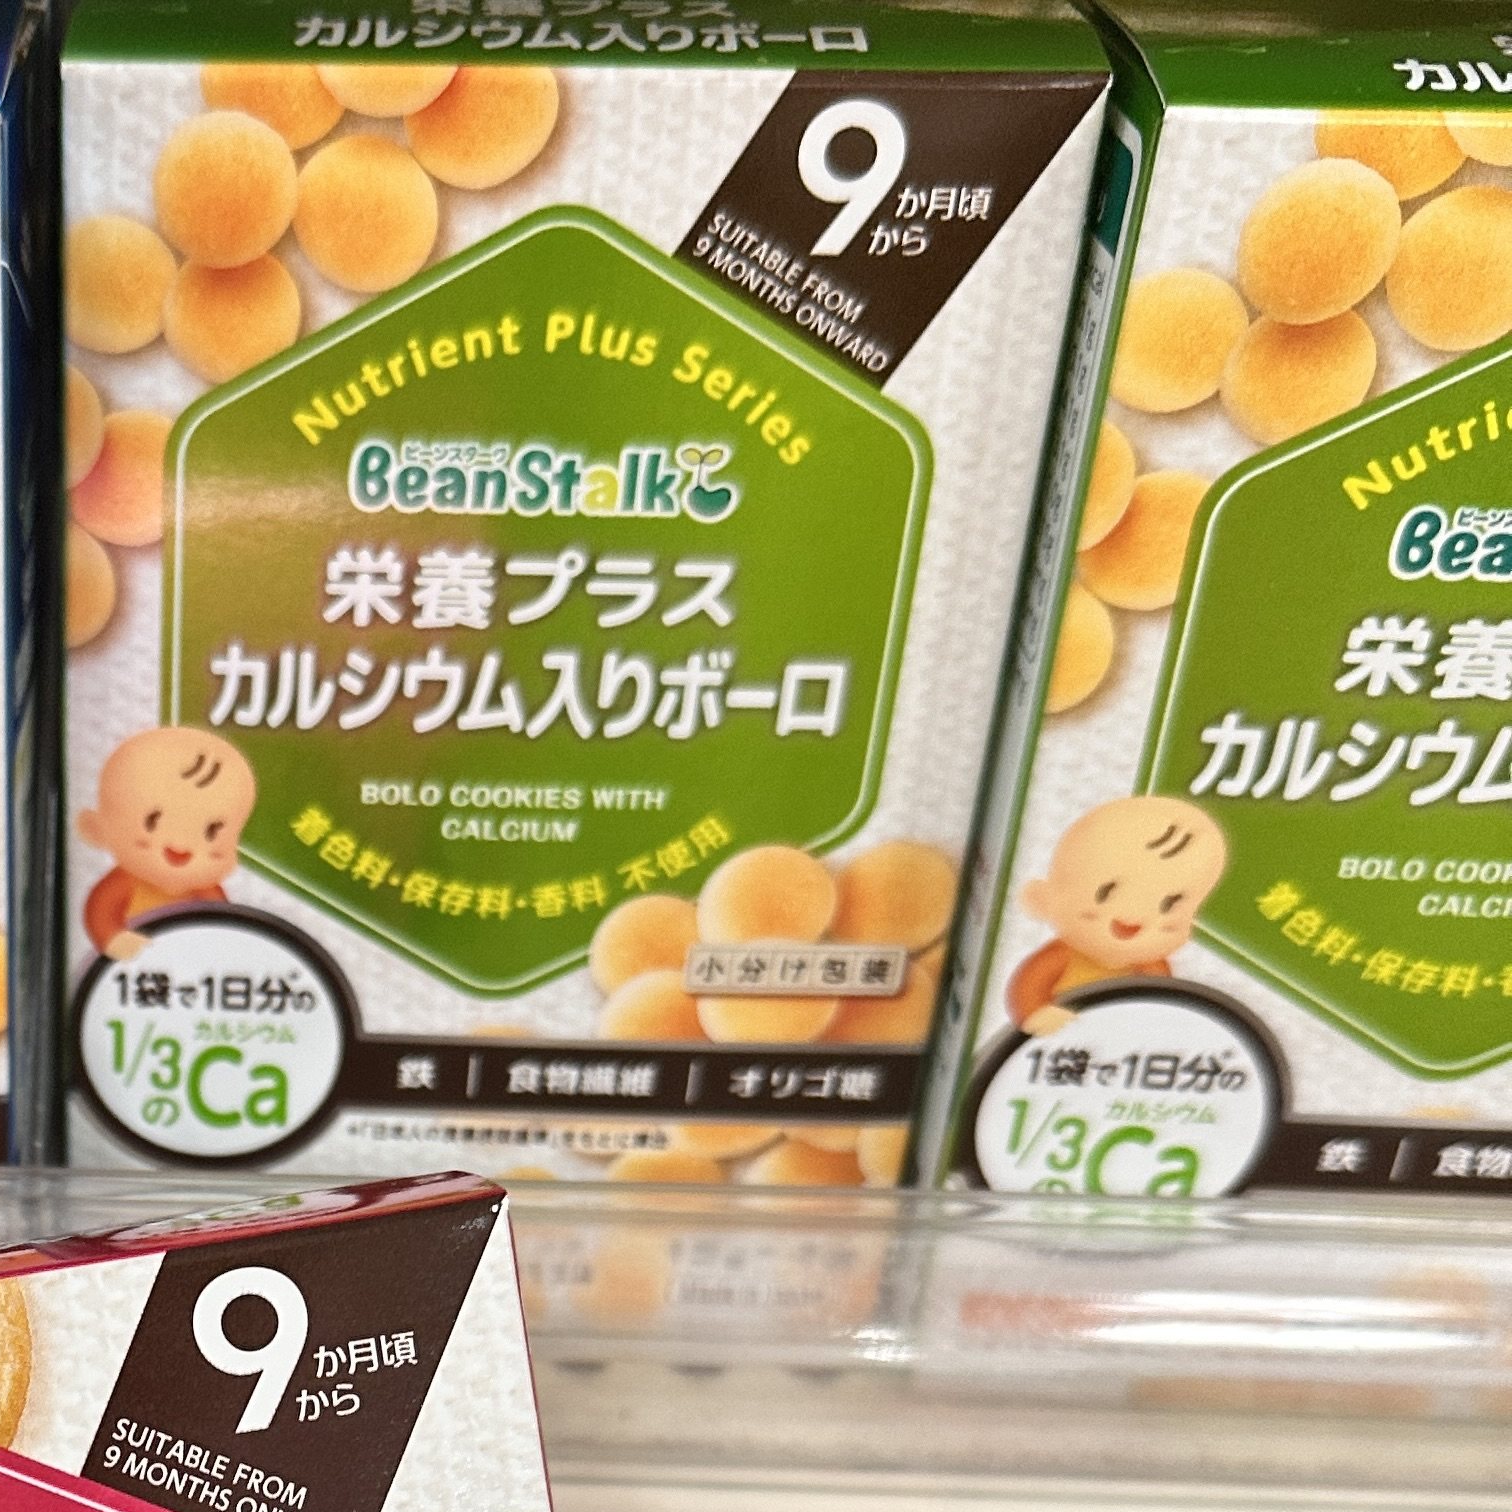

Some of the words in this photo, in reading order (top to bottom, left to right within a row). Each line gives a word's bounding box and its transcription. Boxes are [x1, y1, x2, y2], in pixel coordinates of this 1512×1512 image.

[293, 16, 870, 53] カルシウム入りボーロ
[797, 99, 906, 258] 9
[894, 187, 993, 221] か月頃
[706, 212, 802, 284] SUITABLE
[801, 274, 868, 324] FROM
[868, 224, 930, 257] から
[692, 235, 709, 259] 9
[708, 246, 798, 314] MONTHS
[795, 305, 890, 373] ONWARD
[291, 313, 523, 448] Nutrient
[544, 312, 659, 367] Plus
[672, 344, 813, 468] Series
[347, 437, 683, 519] BeanStalk
[1341, 400, 1512, 511] Nutri
[321, 547, 735, 631] 栄養プラス
[207, 644, 849, 741] カルシウム入りボーロ
[1333, 613, 1512, 701] 栄養
[359, 782, 442, 807] BOLO
[449, 784, 582, 811] COOKIES
[591, 787, 669, 812] WITH
[439, 816, 580, 844] CALCIUM
[617, 814, 735, 891] 不使用
[1338, 856, 1428, 882] BOLO
[695, 953, 893, 985] 小分け包装
[105, 1019, 183, 1091] 1/3
[189, 1043, 288, 1129] Ca
[728, 1066, 879, 1101] オリゴ糖
[140, 1096, 182, 1128] の
[1086, 1125, 1200, 1197] Ca
[192, 1265, 310, 1436] 9
[312, 1329, 420, 1379] か月頃
[295, 1382, 361, 1423] から
[102, 1442, 119, 1470] 9
[120, 1448, 231, 1512] MONTHS
[112, 1417, 232, 1481] SUITABLE
[232, 1463, 309, 1511] FROM
